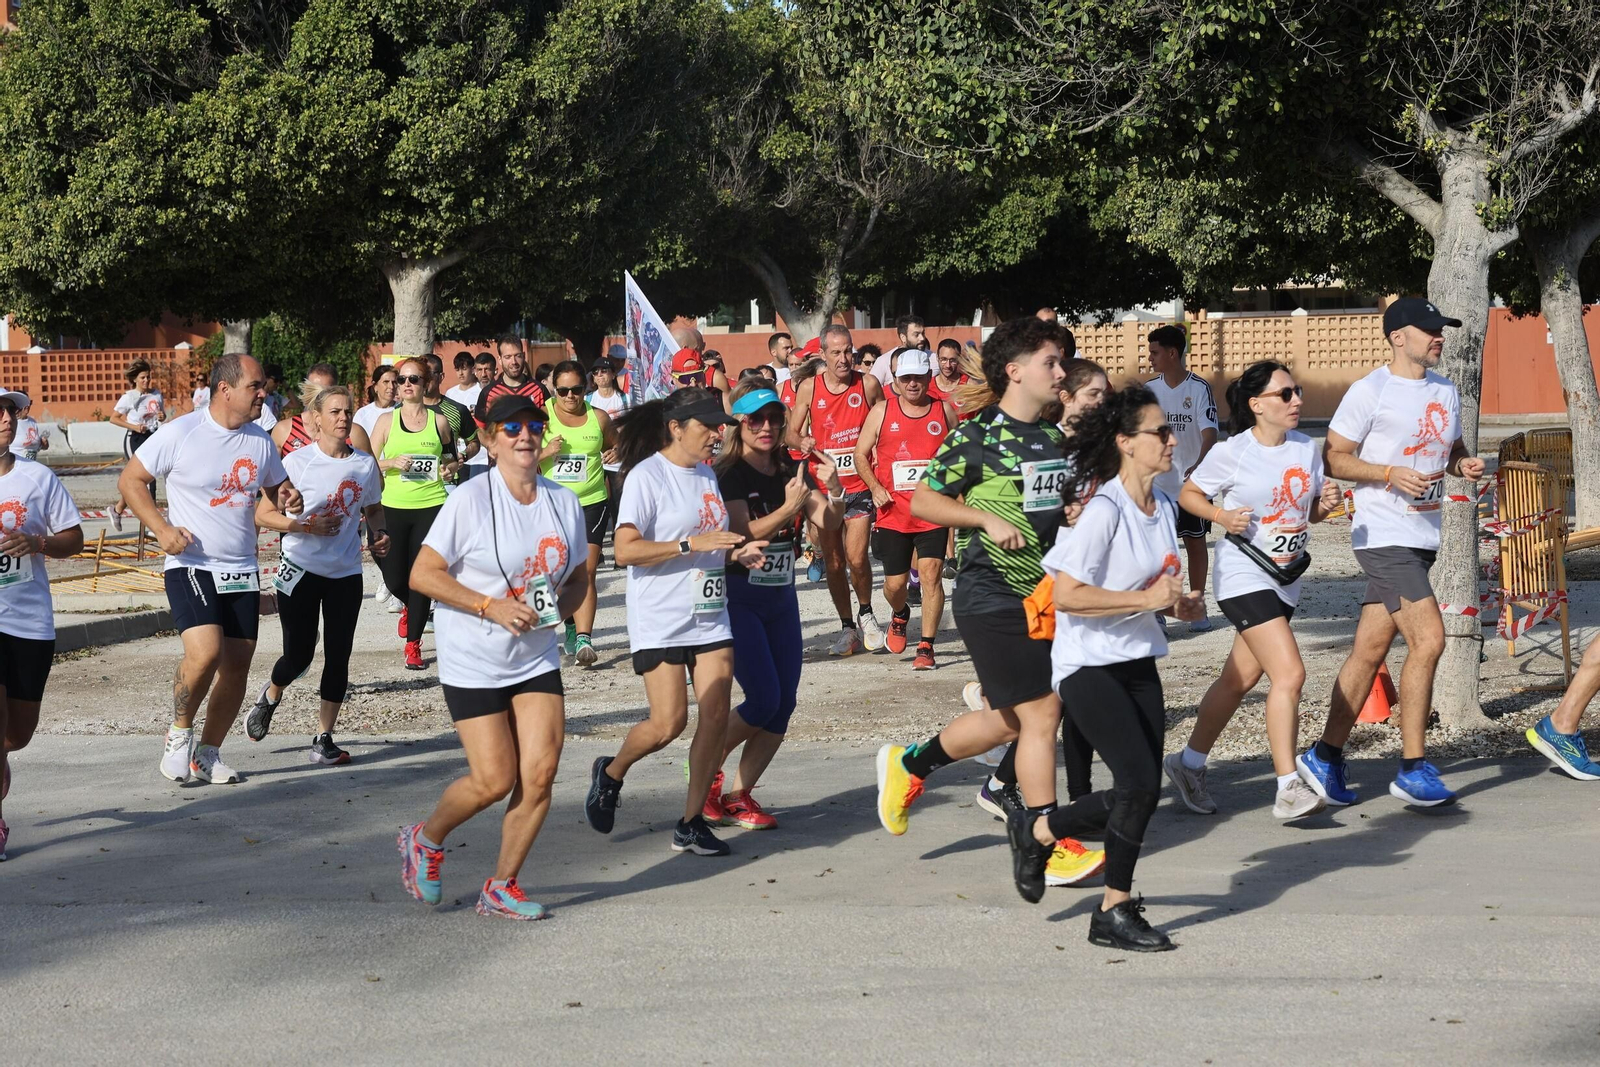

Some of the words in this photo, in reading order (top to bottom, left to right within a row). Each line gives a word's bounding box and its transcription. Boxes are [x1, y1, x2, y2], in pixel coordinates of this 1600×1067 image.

[1165, 411, 1193, 423] irates
[410, 460, 433, 473] 38
[557, 461, 582, 473] 739
[836, 455, 852, 468] 18
[907, 468, 917, 481] 2
[1032, 472, 1066, 495] 448
[1271, 531, 1308, 553] 263
[761, 553, 791, 573] 641
[703, 577, 725, 599] 69
[533, 590, 555, 612] 6
